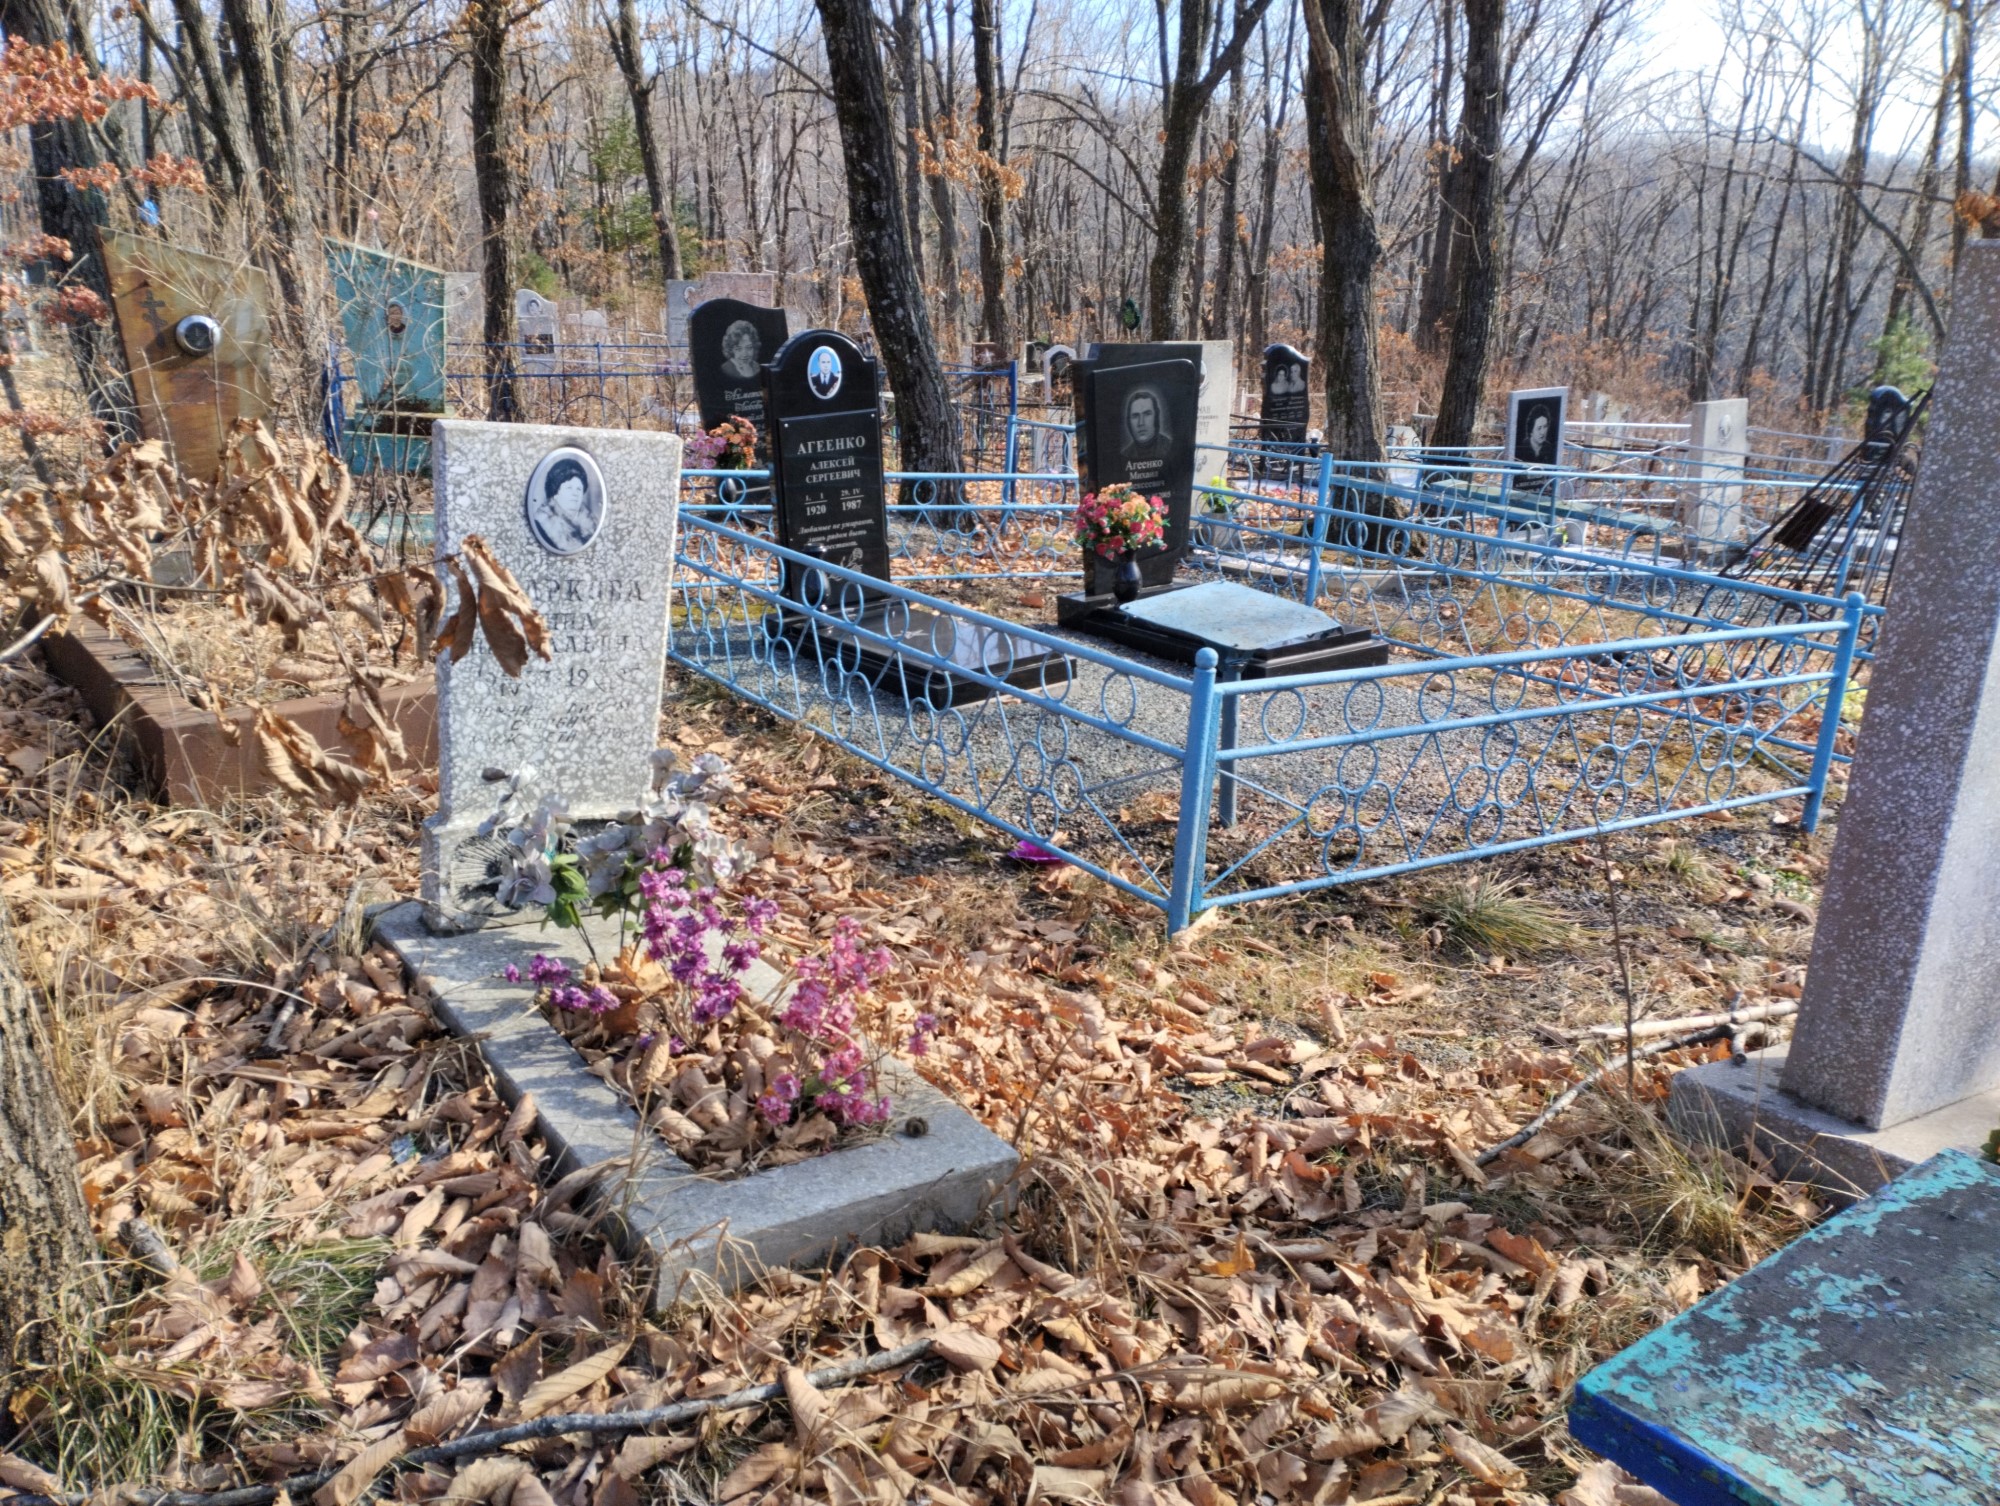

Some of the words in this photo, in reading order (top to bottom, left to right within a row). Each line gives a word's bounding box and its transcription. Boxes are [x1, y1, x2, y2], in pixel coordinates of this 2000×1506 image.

[797, 435, 866, 455] АГЕЕНКО
[810, 456, 855, 471] АЛЕКСЕЙ
[1125, 459, 1163, 471] Агеенко
[805, 469, 861, 484] СЕРГЕЕВИЧ
[1129, 471, 1159, 480] Михаил
[1132, 480, 1165, 490] ексеевич
[806, 505, 827, 516] 1920
[841, 500, 862, 511] 1987
[799, 524, 831, 535] Любимые
